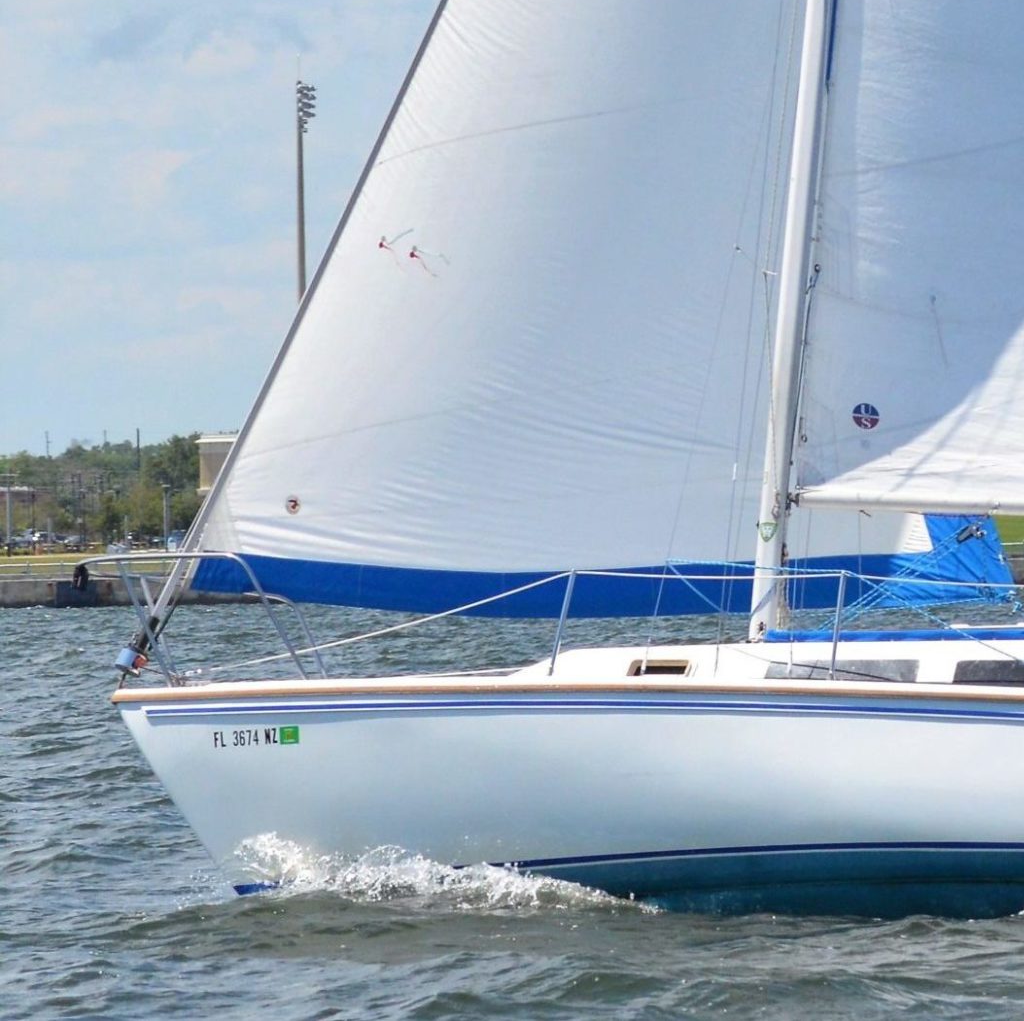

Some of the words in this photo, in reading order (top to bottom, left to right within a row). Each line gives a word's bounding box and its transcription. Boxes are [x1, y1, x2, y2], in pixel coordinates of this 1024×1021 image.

[213, 731, 227, 748] FL
[232, 729, 259, 747] 3674
[264, 727, 278, 744] NZ
